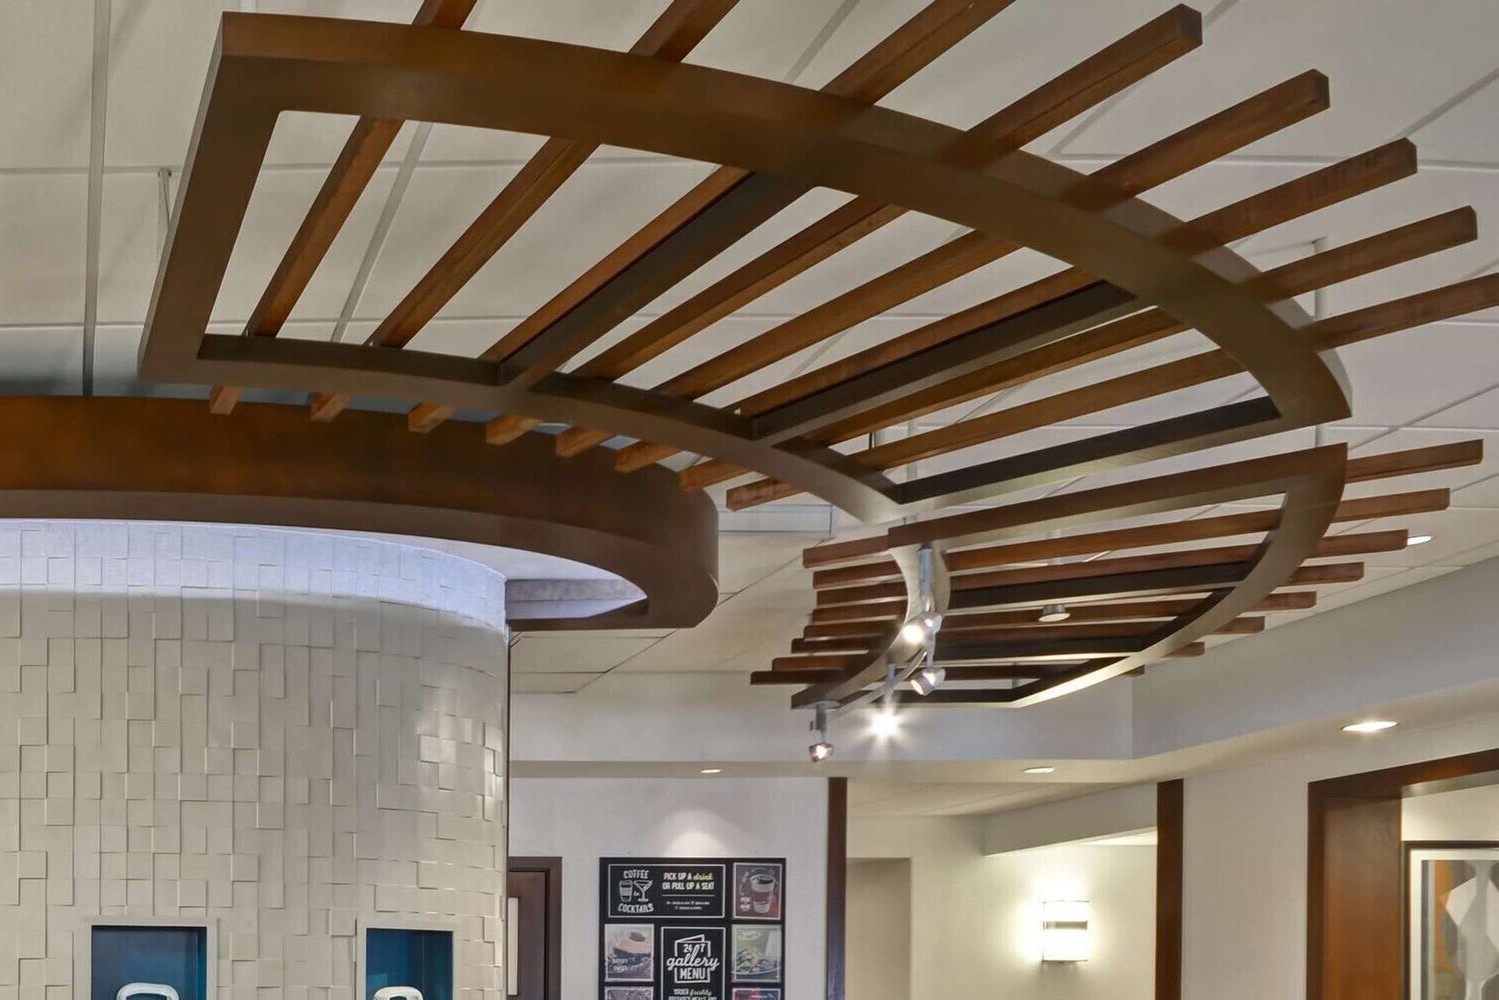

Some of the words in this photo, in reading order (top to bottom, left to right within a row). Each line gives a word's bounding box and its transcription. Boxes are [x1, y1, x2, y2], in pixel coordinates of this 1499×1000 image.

[623, 869, 650, 880] COFFEE
[663, 872, 677, 880] PICK
[678, 872, 686, 880] UP
[662, 882, 671, 890] OR
[671, 882, 685, 890] PULL
[686, 882, 694, 890] UP
[701, 882, 715, 890] SEAT
[617, 903, 654, 913] COCKTAILS
[666, 944, 720, 971] gallery
[680, 967, 706, 980] MENU
